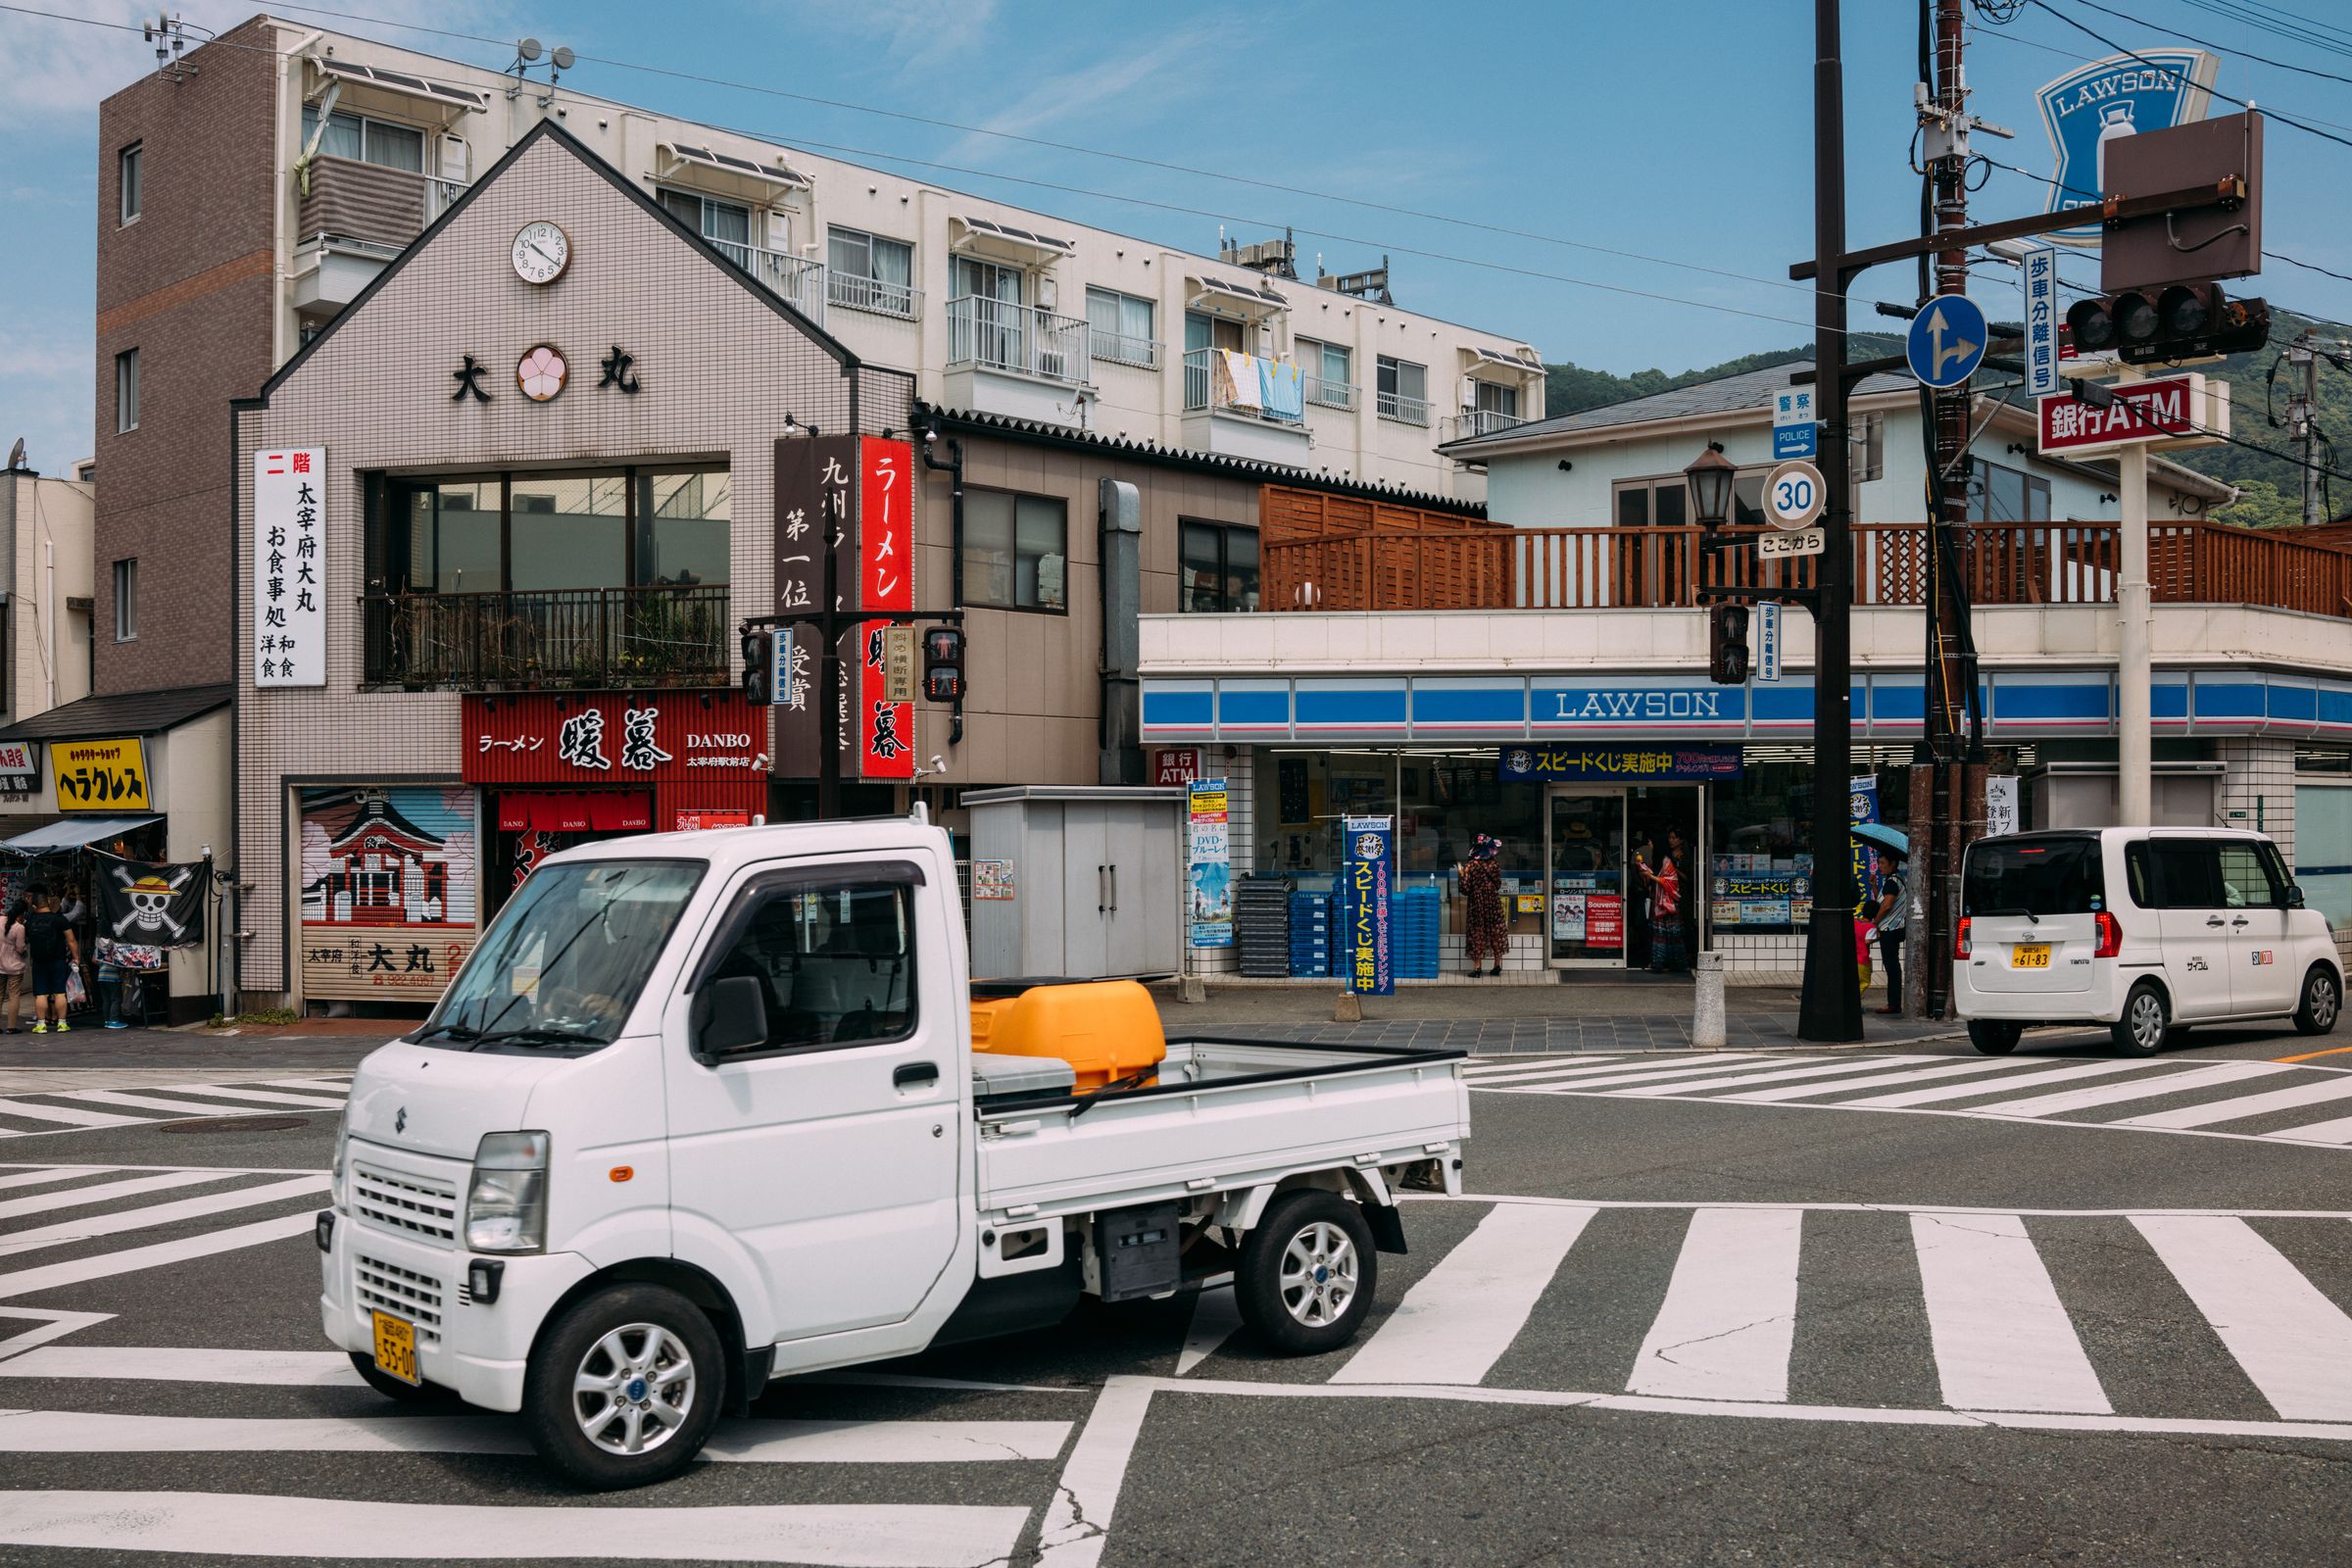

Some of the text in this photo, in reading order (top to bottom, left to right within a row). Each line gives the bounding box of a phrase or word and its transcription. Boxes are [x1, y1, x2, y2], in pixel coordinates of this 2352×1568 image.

[2055, 70, 2180, 119] LAWSON
[2031, 257, 2050, 388] 歩車分離信号
[453, 345, 641, 402] 大 丸
[1779, 393, 1810, 413] 警察
[2051, 389, 2181, 440] 銀行ATM
[1780, 429, 1810, 442] POLICE
[268, 453, 311, 474] 二階
[1777, 480, 1811, 512] 30
[875, 457, 898, 598] ラーメン
[295, 481, 318, 612] 太宰府大丸
[1763, 534, 1820, 553] ここから
[265, 525, 286, 628] お食事処
[1556, 692, 1720, 717] LAWSON
[479, 735, 545, 753] ラーメン
[686, 733, 751, 748] DANBO
[1162, 753, 1192, 766] 銀行
[1536, 752, 1672, 773] スピードくじ実施中
[60, 766, 142, 802] ヘラクレス
[1160, 767, 1194, 783] ATM
[1730, 884, 1789, 894] スピードくじ
[1354, 861, 1375, 992] スピードくじ実施中
[308, 949, 343, 963] 太宰府
[368, 943, 435, 973] 大丸
[2187, 961, 2208, 971] サイコム
